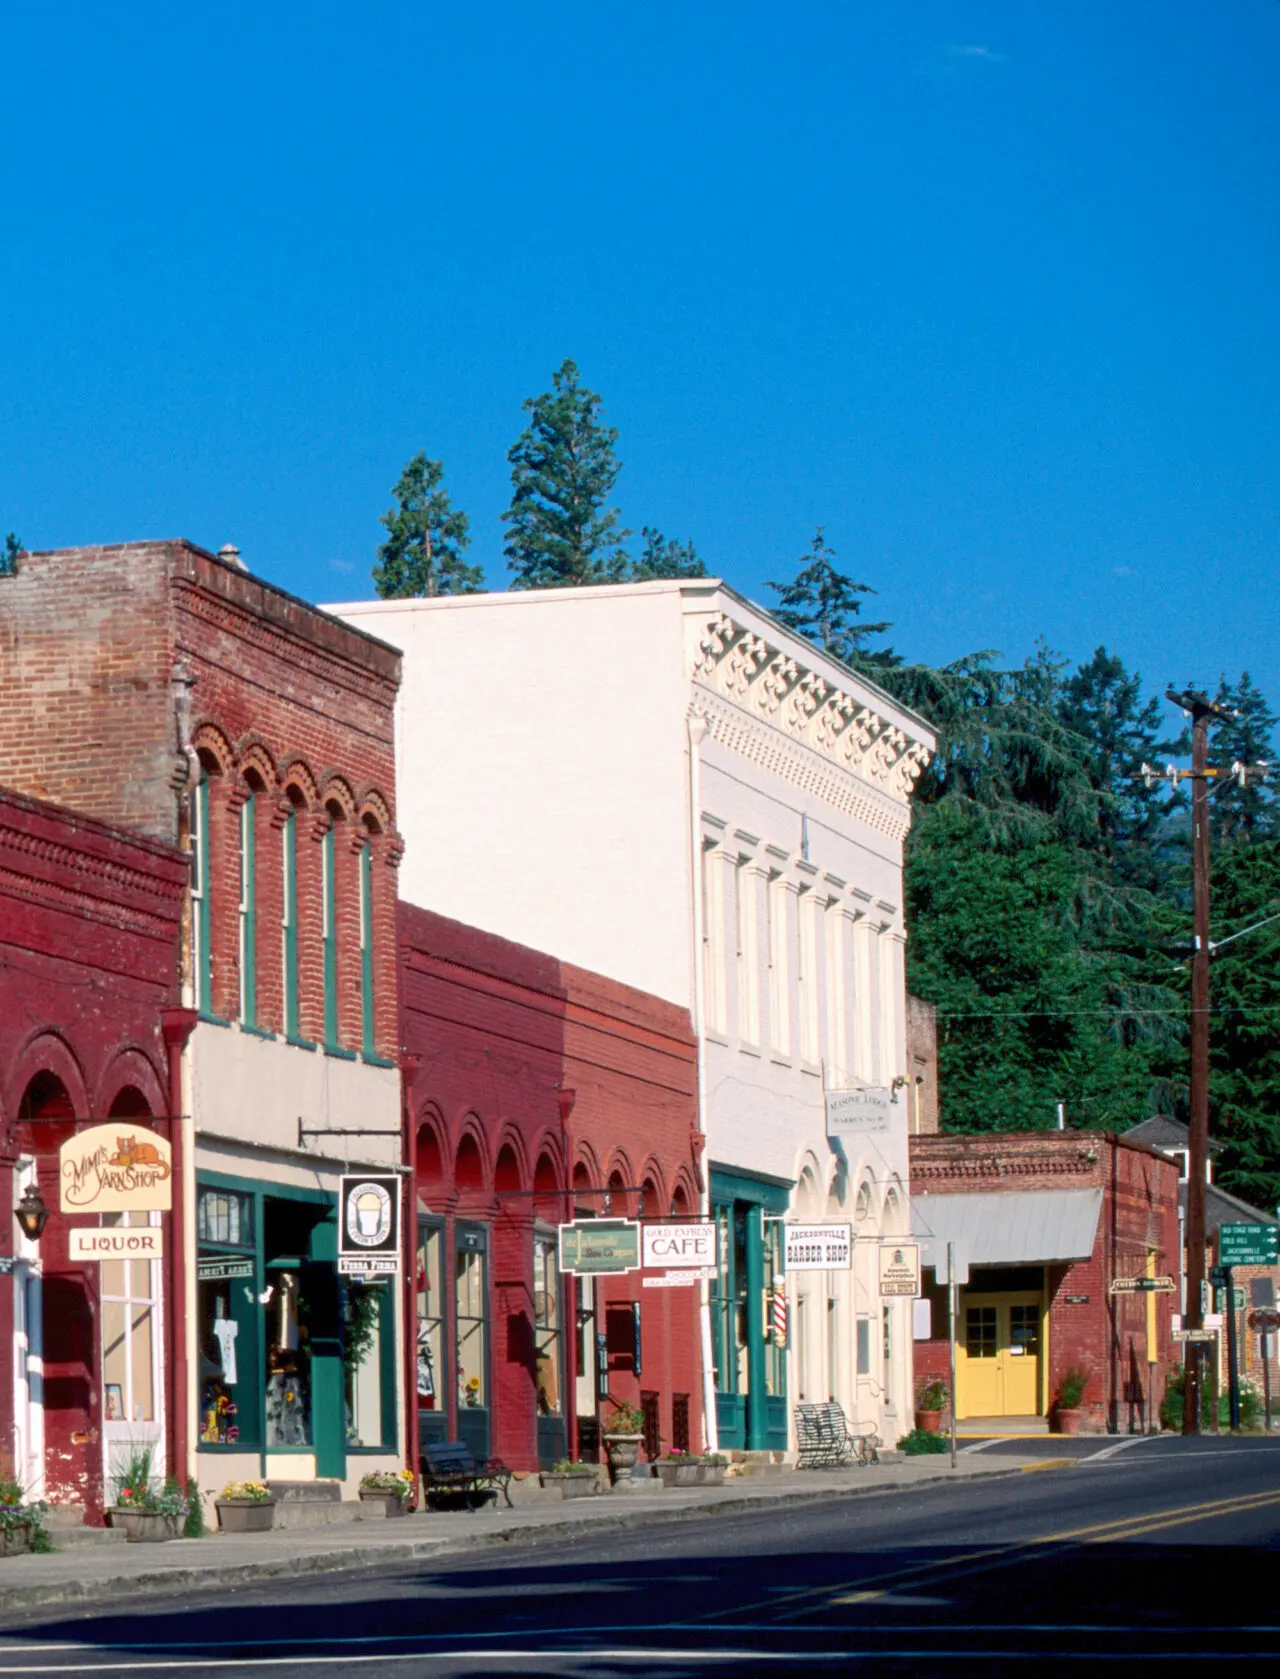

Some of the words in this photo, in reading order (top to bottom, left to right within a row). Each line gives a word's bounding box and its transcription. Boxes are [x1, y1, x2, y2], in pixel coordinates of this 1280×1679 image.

[790, 1230, 846, 1241] JACKSONVILLE
[78, 1236, 156, 1252] LIQUOR
[651, 1238, 708, 1255] CAFE
[787, 1245, 822, 1263] BARBER
[826, 1244, 849, 1262] SHOP
